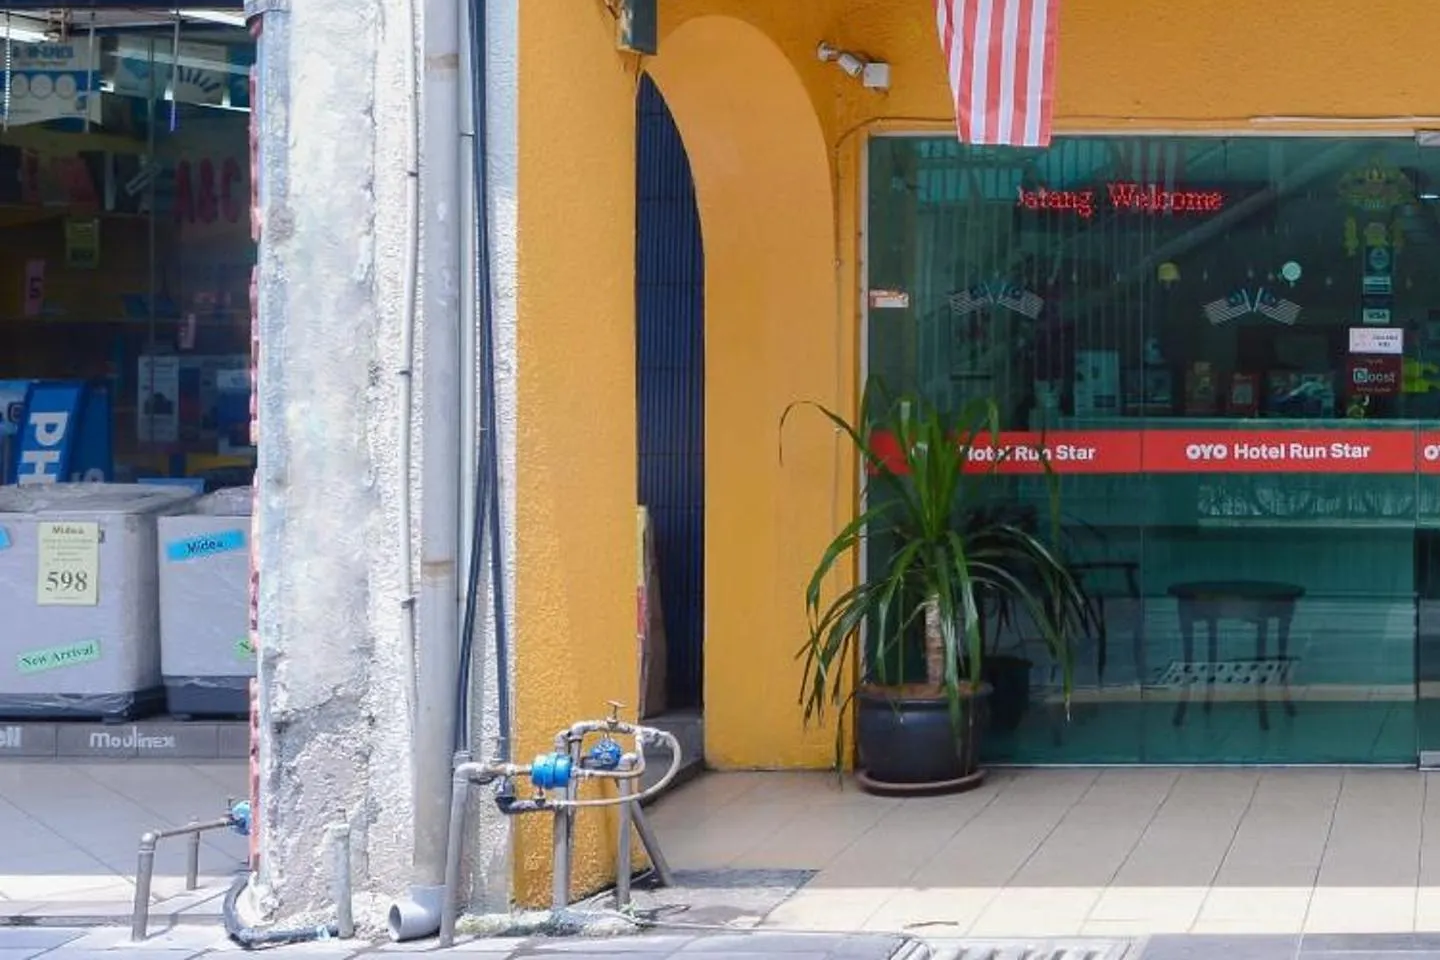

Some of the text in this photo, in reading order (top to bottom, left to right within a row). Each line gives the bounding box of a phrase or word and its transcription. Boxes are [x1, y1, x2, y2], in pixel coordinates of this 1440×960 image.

[1106, 183, 1225, 211] Welcome
[1056, 444, 1097, 461] Star
[1185, 442, 1371, 460] OYO Hotel Run Star
[45, 570, 88, 593] 598
[21, 643, 95, 668] New Arrival
